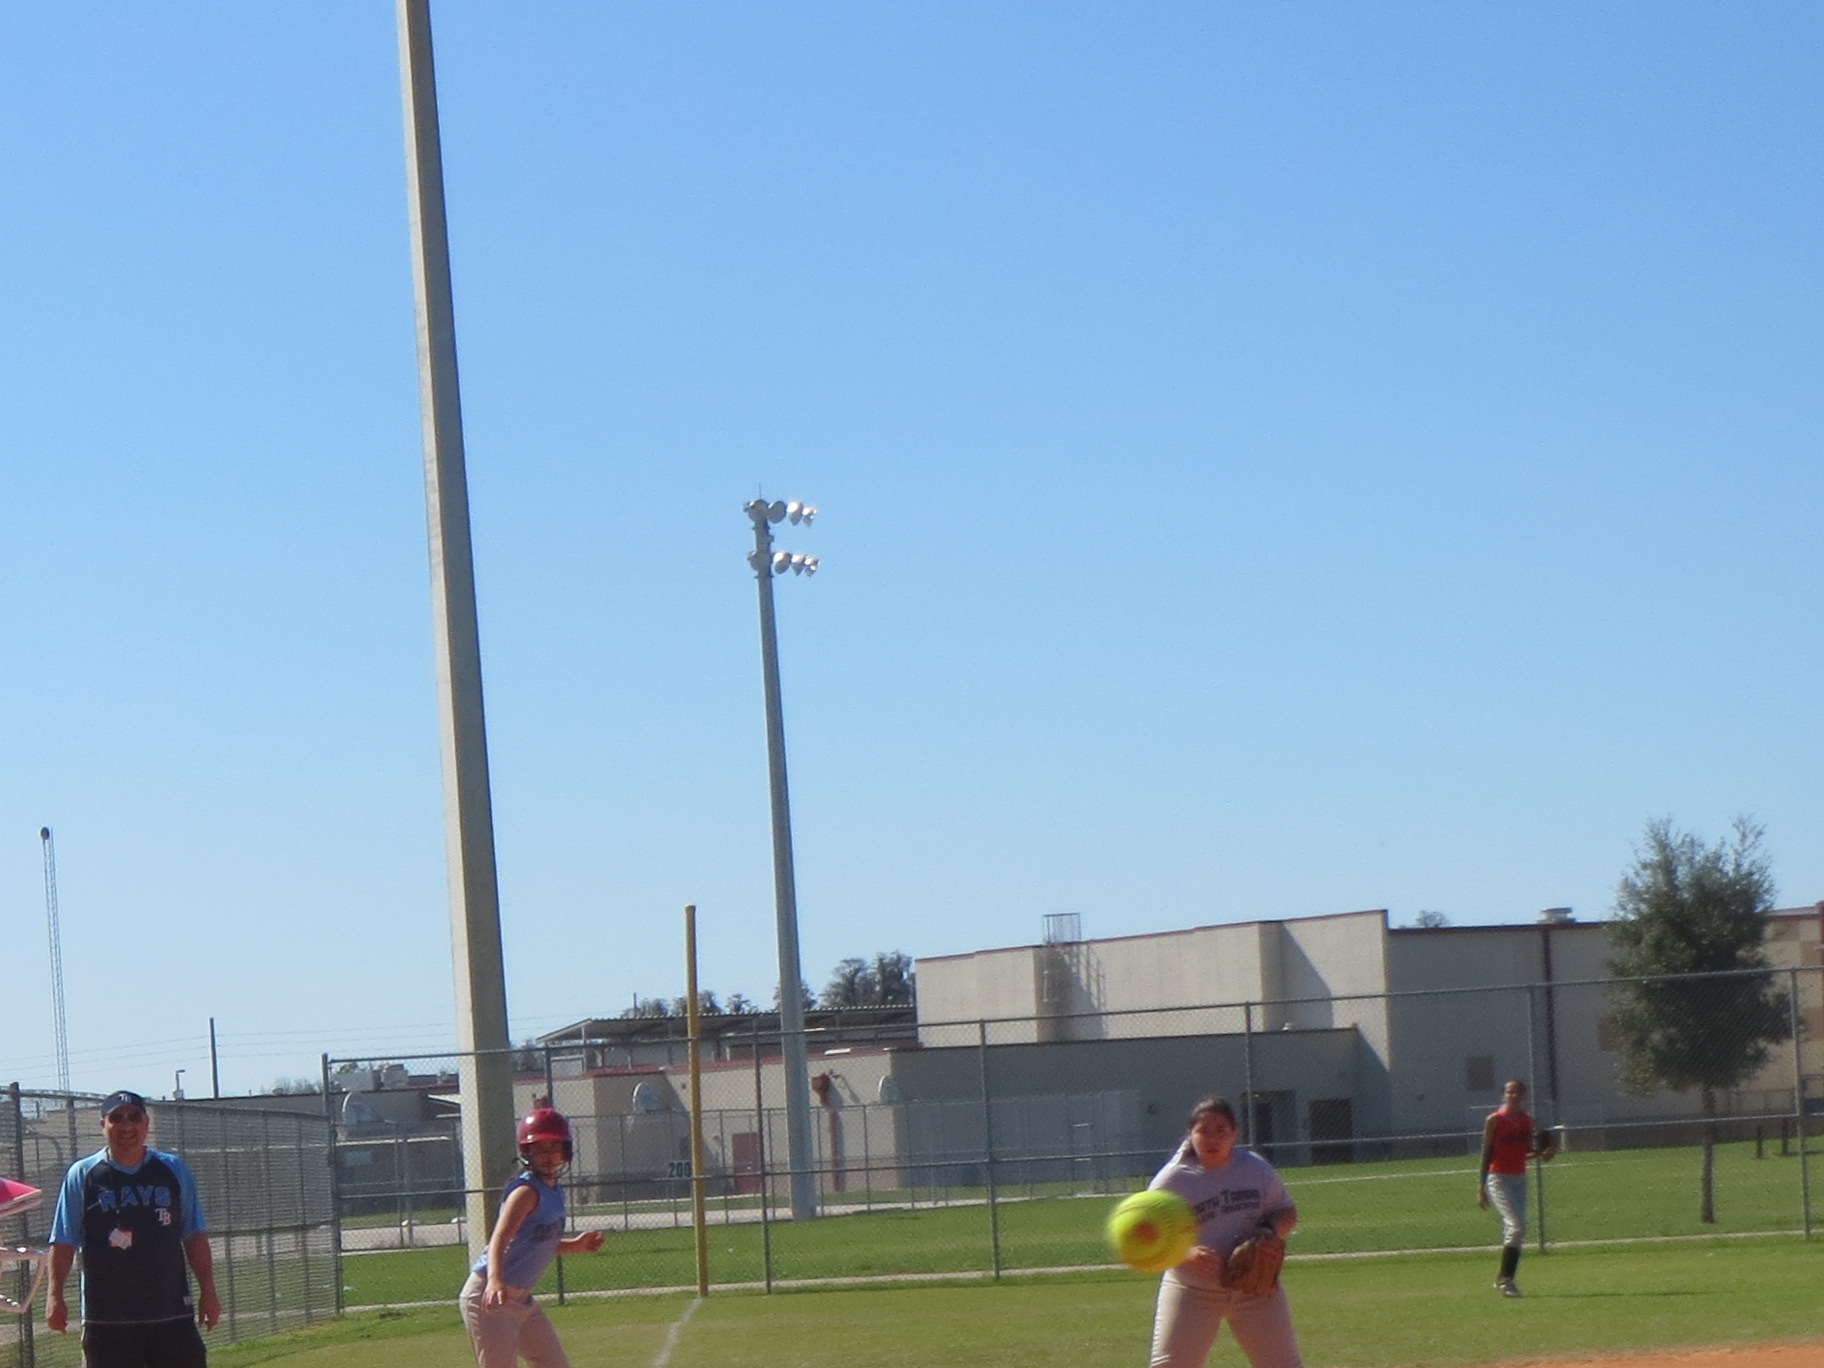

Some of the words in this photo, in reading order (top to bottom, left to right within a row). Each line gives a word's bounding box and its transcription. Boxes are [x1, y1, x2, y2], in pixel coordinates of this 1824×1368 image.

[667, 1161, 691, 1178] 200
[98, 1186, 172, 1212] RAYS
[155, 1208, 172, 1226] TB
